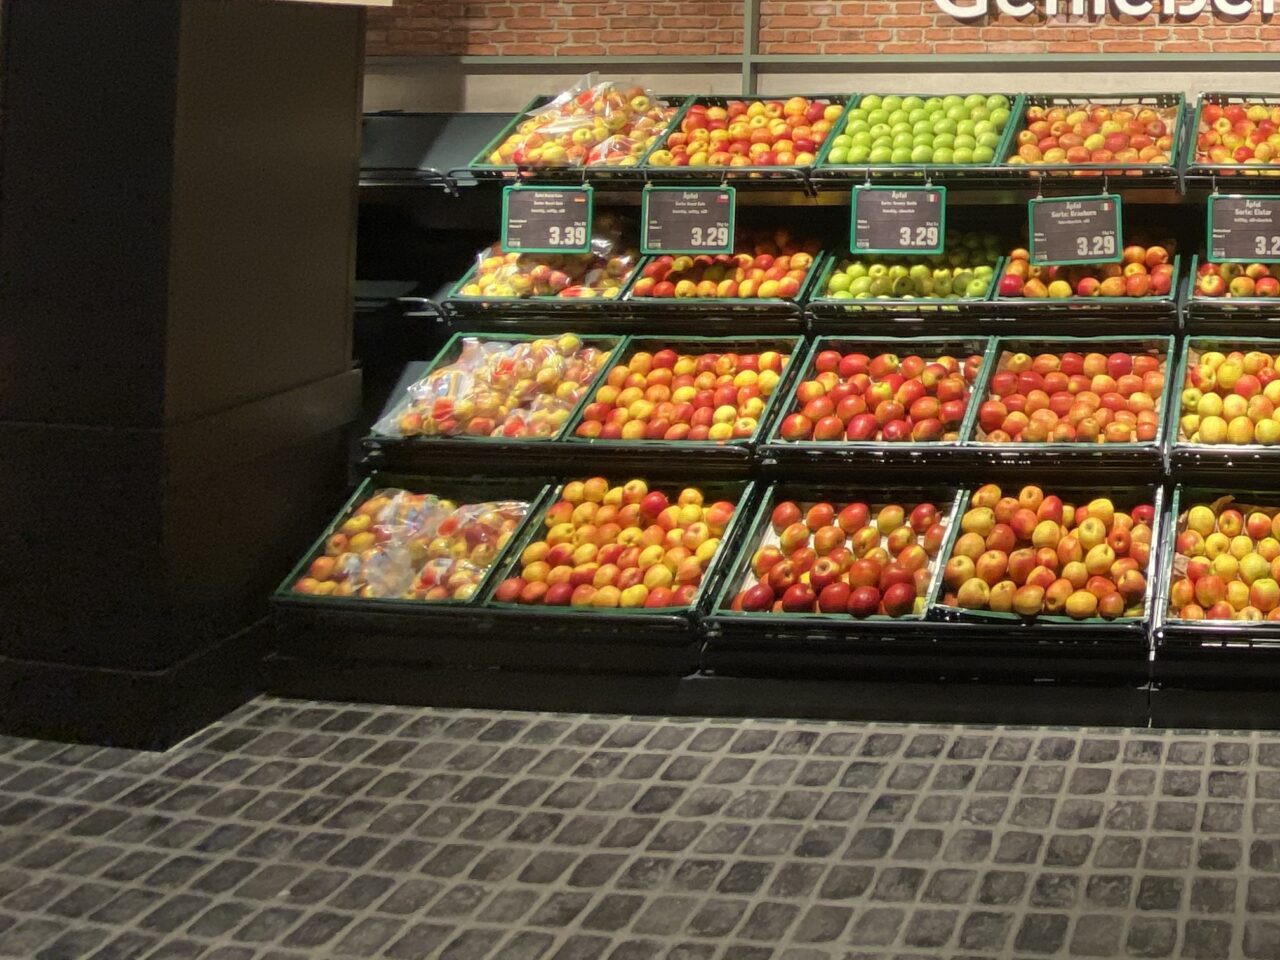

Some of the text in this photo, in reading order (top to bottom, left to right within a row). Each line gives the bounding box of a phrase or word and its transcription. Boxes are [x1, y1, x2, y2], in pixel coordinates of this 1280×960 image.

[549, 226, 586, 245] 3.39
[691, 227, 729, 246] 3.29
[900, 227, 938, 246] 3.29
[1077, 236, 1115, 256] 3.29
